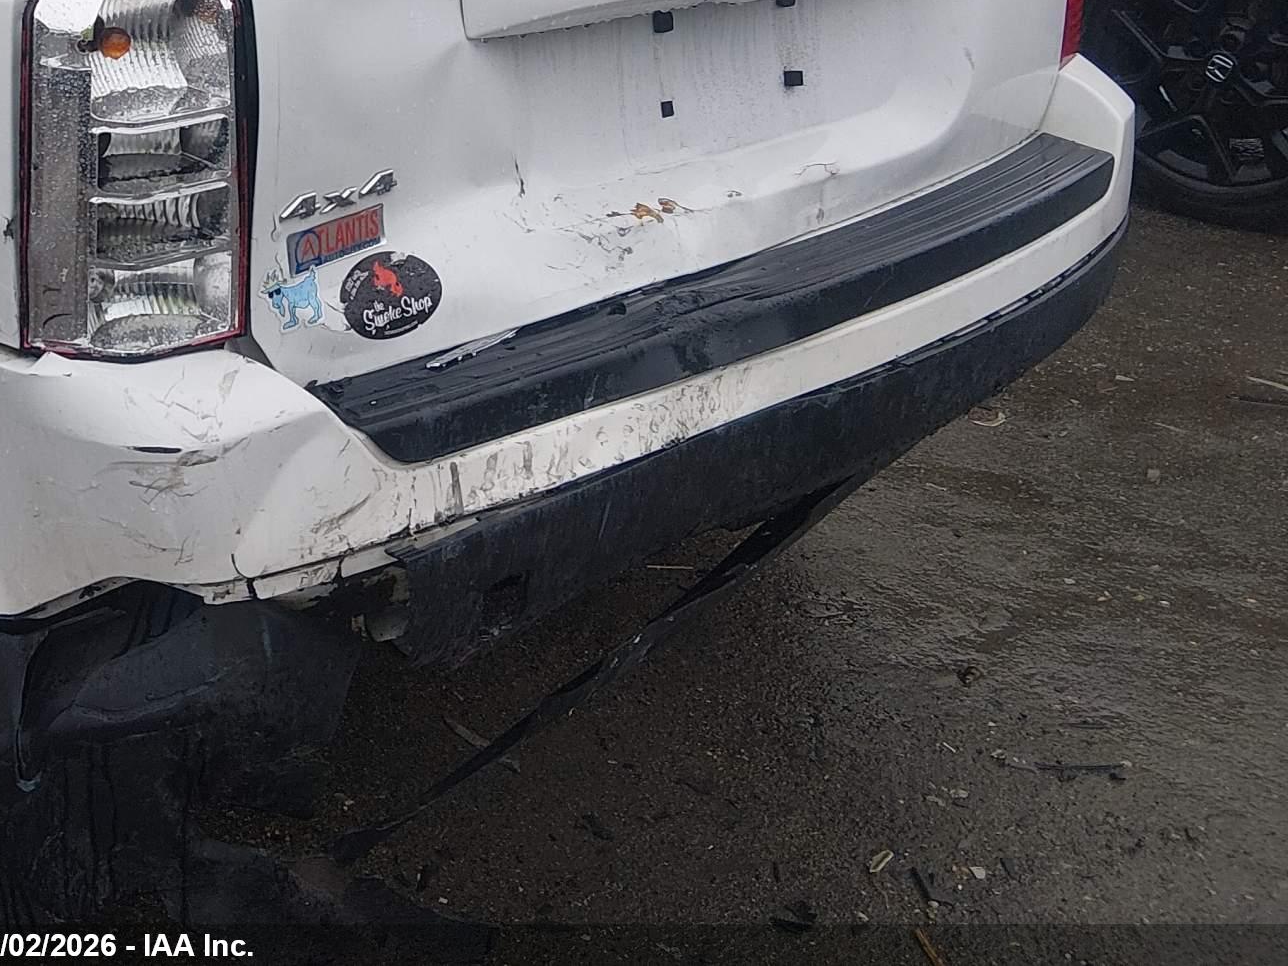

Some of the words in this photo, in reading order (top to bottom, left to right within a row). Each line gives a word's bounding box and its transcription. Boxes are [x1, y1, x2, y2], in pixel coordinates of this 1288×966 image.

[300, 210, 380, 260] ATLANTIS
[362, 303, 403, 336] Smoke
[400, 295, 433, 317] Shop
